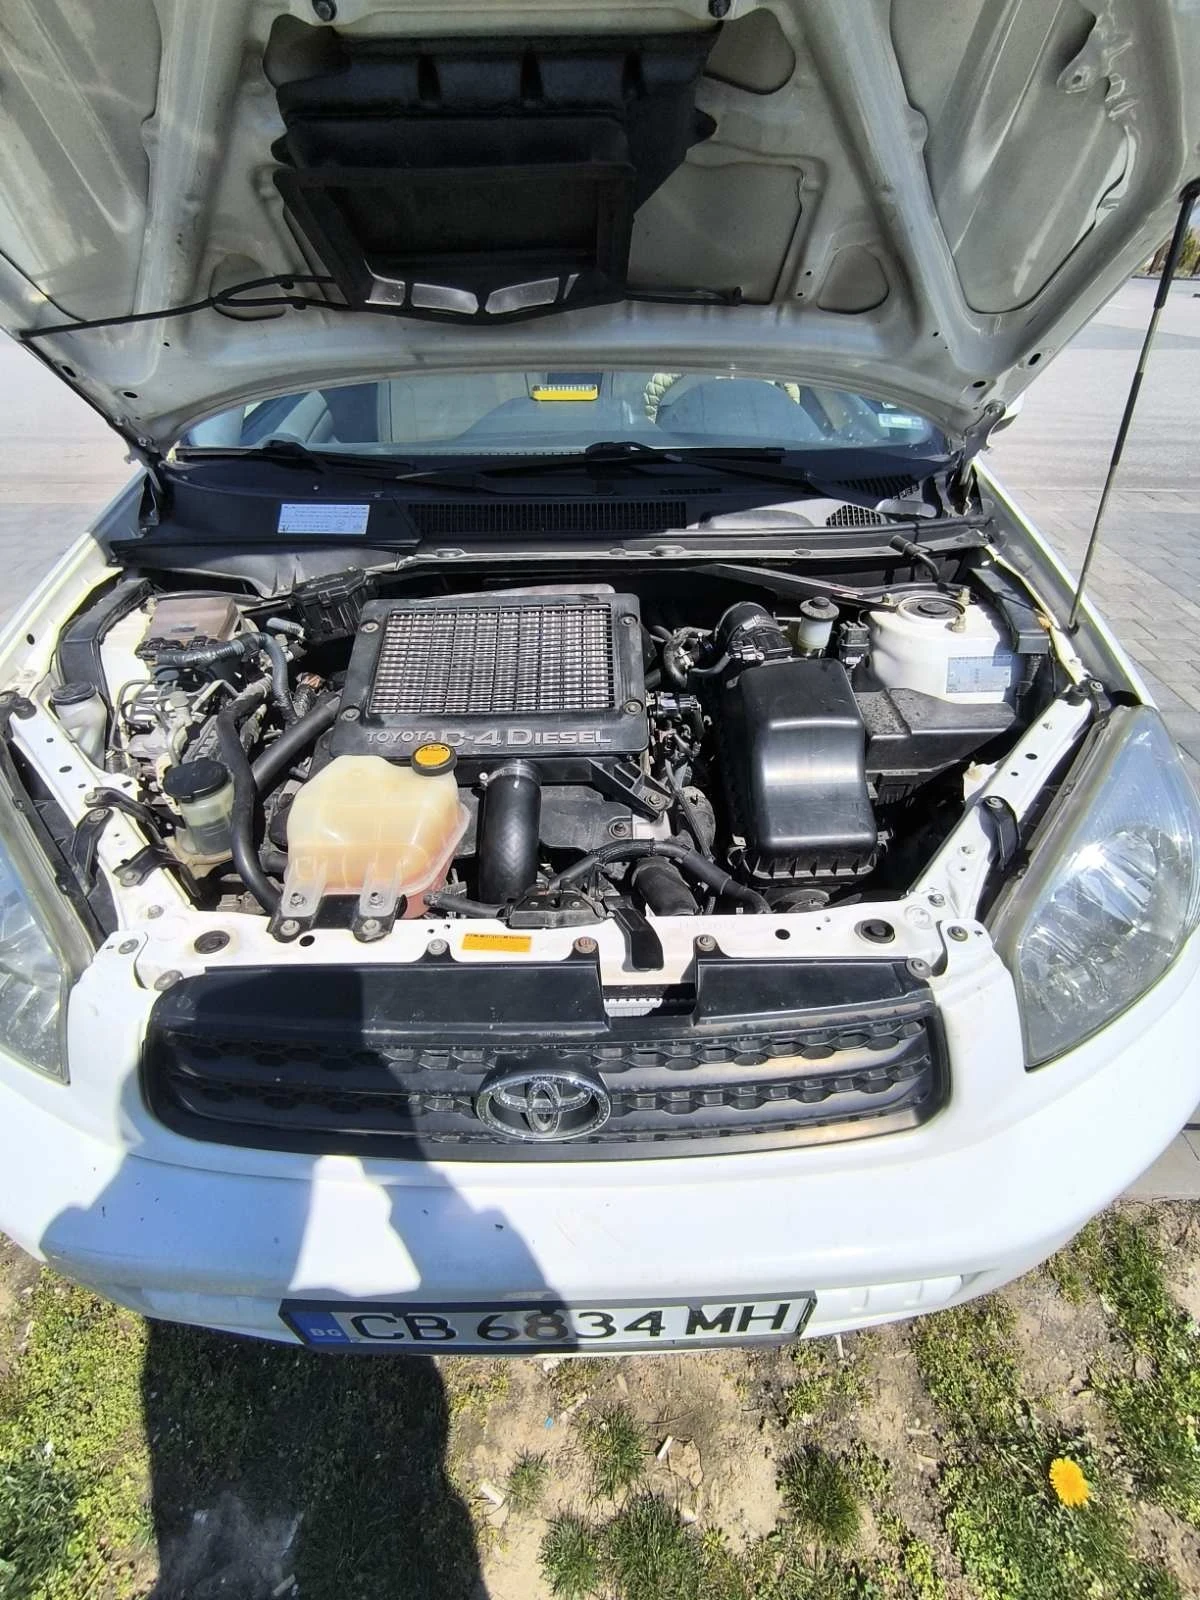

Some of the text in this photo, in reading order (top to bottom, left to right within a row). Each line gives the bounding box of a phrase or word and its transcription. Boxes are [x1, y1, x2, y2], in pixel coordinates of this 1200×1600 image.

[367, 730, 438, 745] TOYOTA
[440, 728, 502, 748] D-4
[350, 1303, 791, 1342] CB 6834 MH
[309, 1328, 343, 1338] BG
